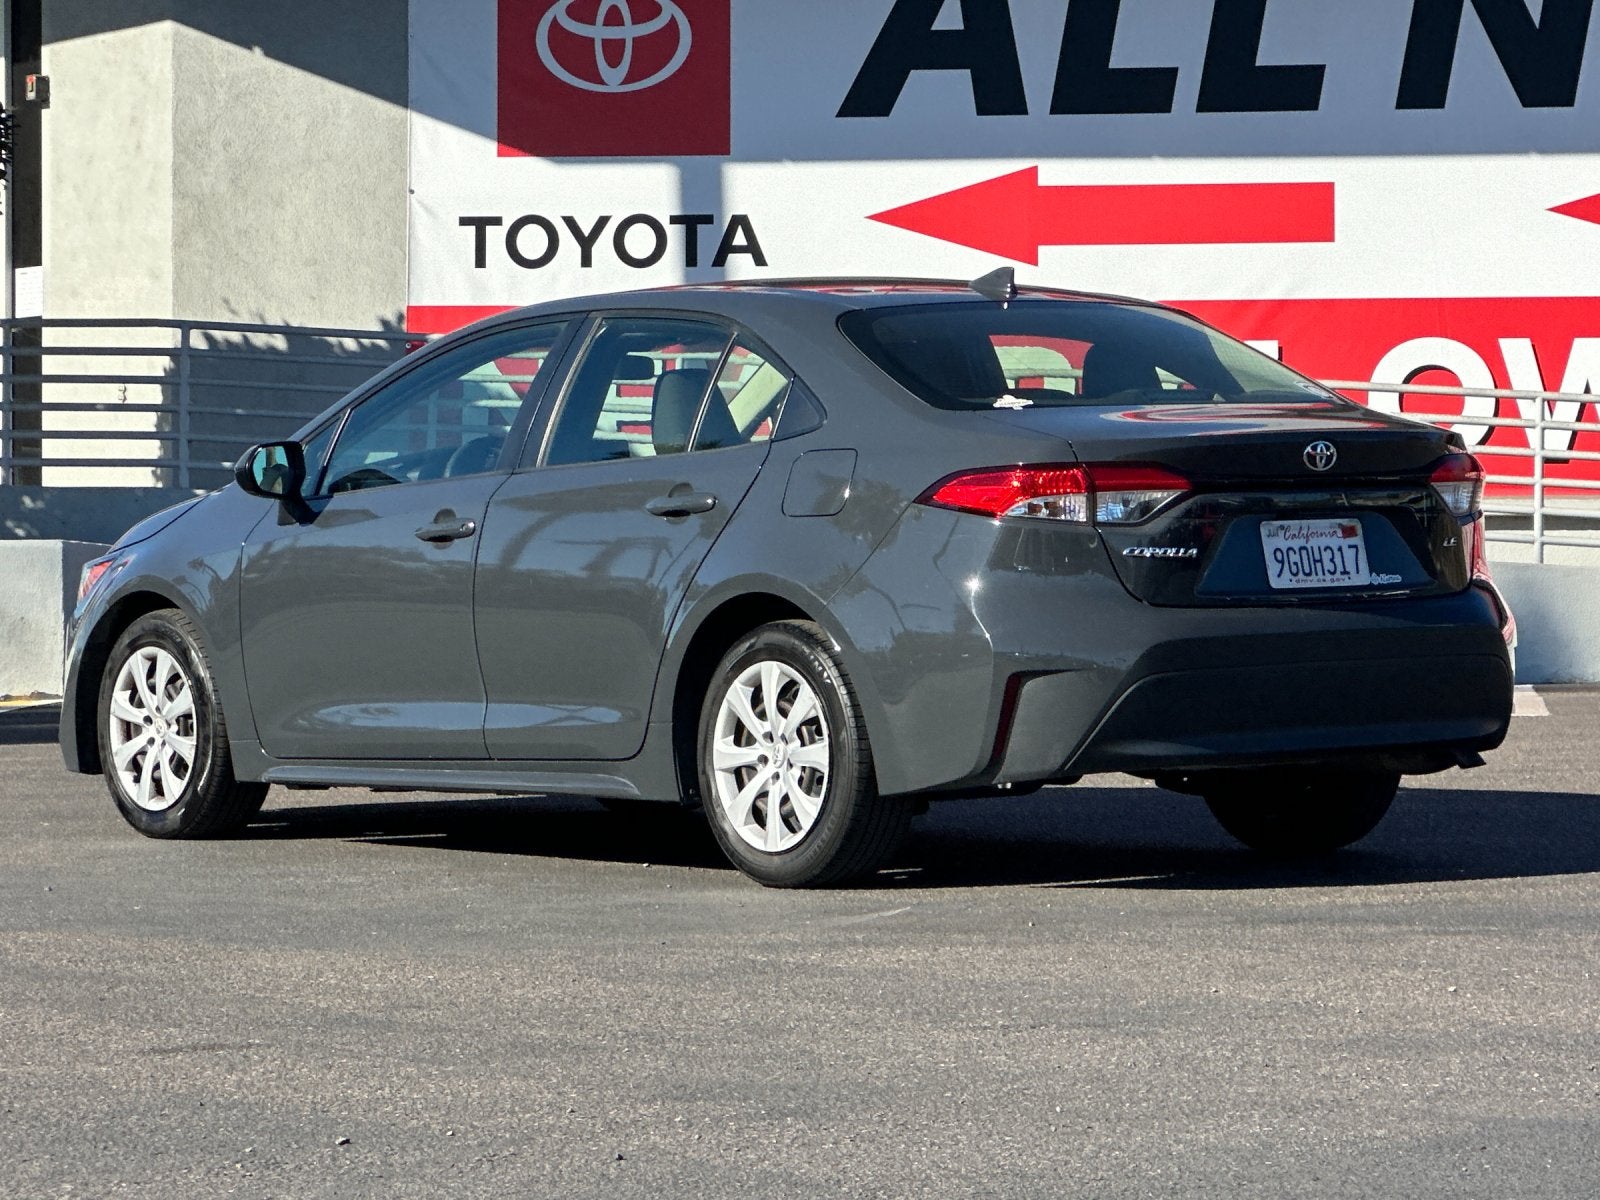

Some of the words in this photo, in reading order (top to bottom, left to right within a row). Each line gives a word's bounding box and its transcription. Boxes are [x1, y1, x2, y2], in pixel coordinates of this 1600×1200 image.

[458, 213, 769, 270] TOYOTA
[1284, 524, 1344, 545] California
[1442, 536, 1457, 547] LE
[1122, 546, 1198, 558] COROLLA
